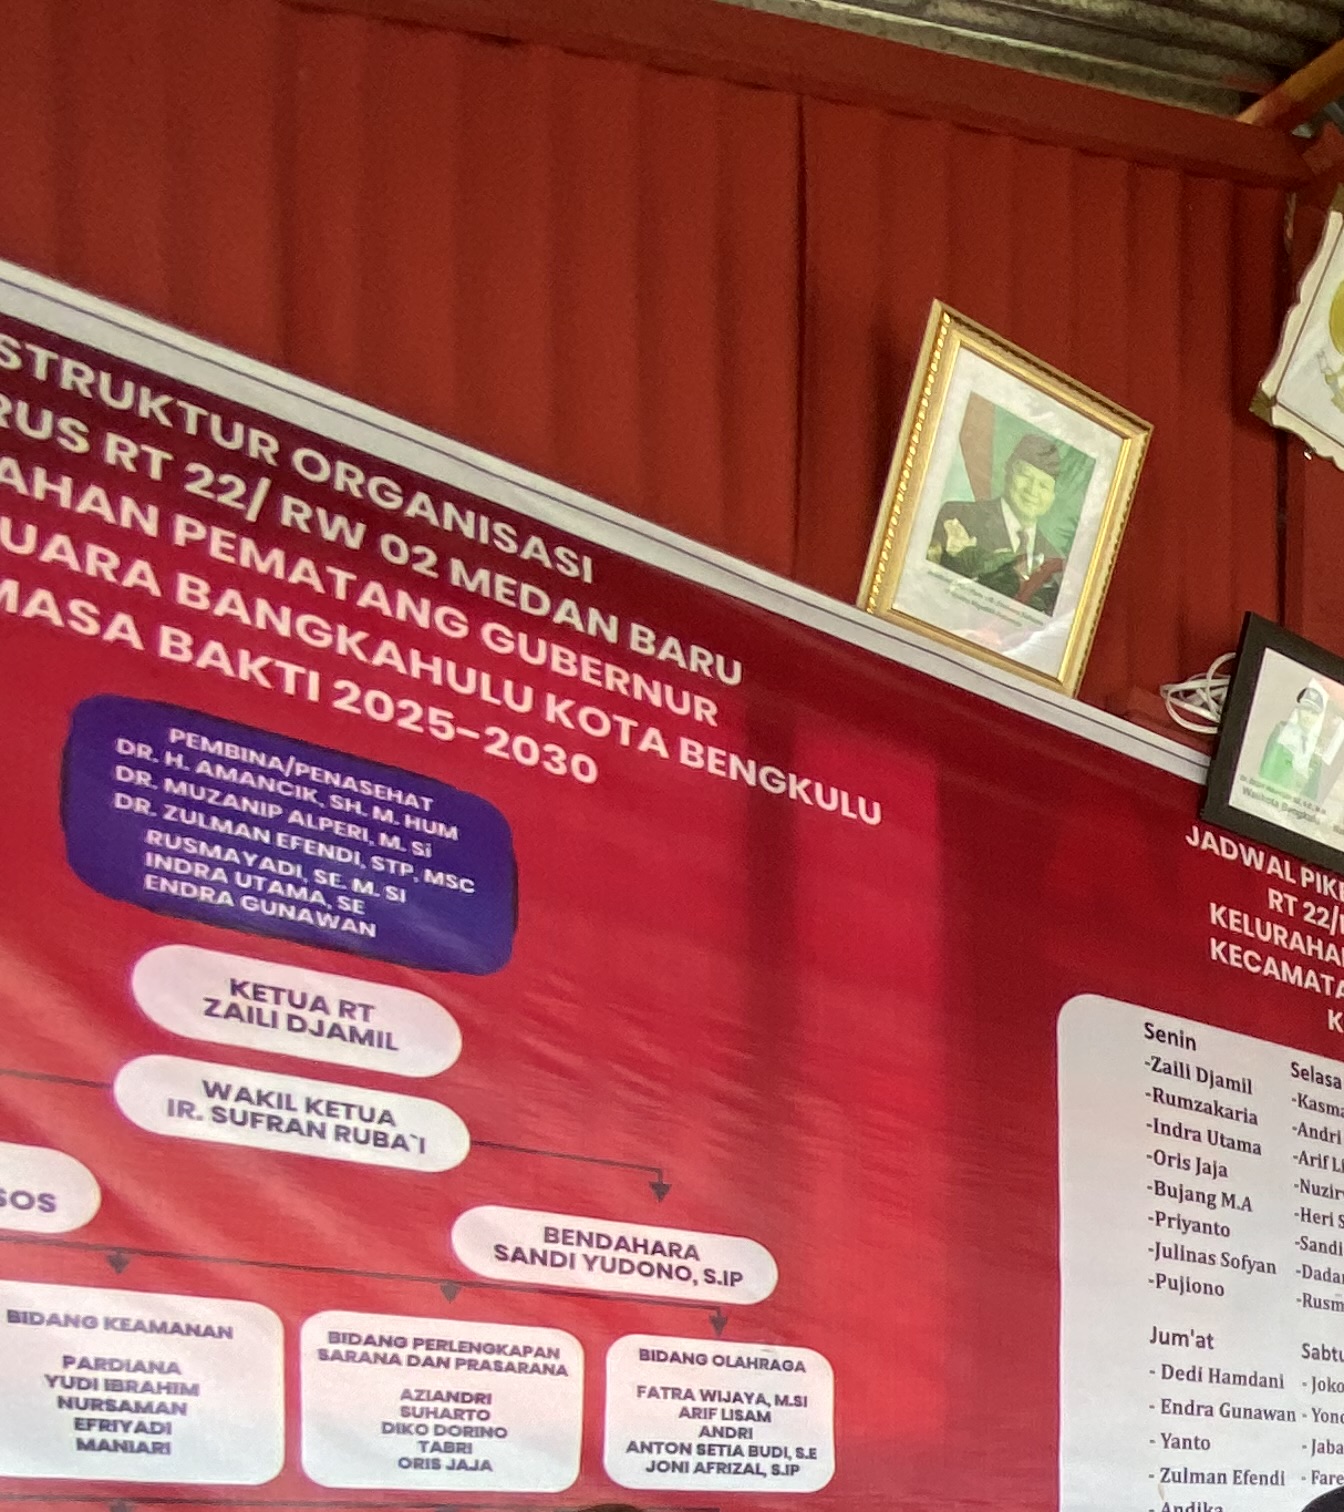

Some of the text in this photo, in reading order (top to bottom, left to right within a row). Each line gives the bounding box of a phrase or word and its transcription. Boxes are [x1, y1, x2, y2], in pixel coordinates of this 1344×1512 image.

[0, 333, 593, 584] STRUKTUR ORGANISASI
[104, 431, 174, 482] RT
[280, 494, 367, 551] RW
[379, 533, 439, 579] 02
[449, 557, 619, 645] MEDAN
[629, 622, 743, 686] BARU
[172, 513, 470, 638] PEMATANG
[480, 622, 719, 728] GUBERNUR
[158, 625, 321, 703] BAKTI
[176, 573, 533, 714] BANGKAHULU
[545, 693, 670, 759] KOTA
[679, 737, 883, 826] BENGKULU
[169, 727, 433, 812] PEMBINA/PENASEHAT
[114, 738, 159, 763] DR.
[165, 750, 190, 772] H.
[372, 802, 400, 826] M.
[405, 812, 459, 841] HUM
[114, 765, 158, 789] DR.
[164, 778, 283, 819] MUZANIP
[378, 831, 407, 853] M.
[411, 840, 433, 859] Si
[113, 792, 157, 817] DR.
[162, 804, 271, 845] ZULMAN
[276, 831, 366, 870] EFENDI,
[424, 868, 476, 894] MSC
[1185, 825, 1297, 885] JADWAL
[144, 852, 366, 917] INDRA UTAMA, SE
[351, 875, 380, 897] M.
[143, 874, 377, 938] ENDRA GUNAWAN
[1267, 887, 1298, 917] RT
[229, 977, 376, 1023] KETUA RT
[203, 997, 399, 1051] ZAILI DJAMIL
[1144, 1021, 1197, 1051] Senin
[1196, 1066, 1252, 1095] Djamil
[1291, 1061, 1343, 1090] Selasa
[202, 1079, 397, 1127] WAKIL KETUA
[166, 1098, 204, 1121] IR.
[211, 1105, 326, 1140] SUFRAN
[1207, 1129, 1262, 1155] Utama
[1195, 1159, 1228, 1180] Jaja
[1220, 1191, 1253, 1212] M.A
[544, 1226, 700, 1261] BENDAHARA
[493, 1244, 743, 1288] SANDI YUDONO, S.IP
[1220, 1251, 1277, 1275] Sofyan
[1149, 1325, 1215, 1350] Jum'at
[638, 1348, 806, 1374] BIDANG OLAHRAGA
[1160, 1363, 1284, 1389] Dedi Hamdani
[636, 1385, 695, 1402] FATRA
[699, 1388, 770, 1408] WIJAYA,
[1311, 1375, 1344, 1394] Joko
[678, 1406, 772, 1424] ARIF LISAM
[1160, 1398, 1296, 1422] Endra Gunawan
[699, 1425, 753, 1440] ANDRI
[1160, 1432, 1211, 1451] Yanto
[1159, 1467, 1286, 1486] Zulman Efendi
